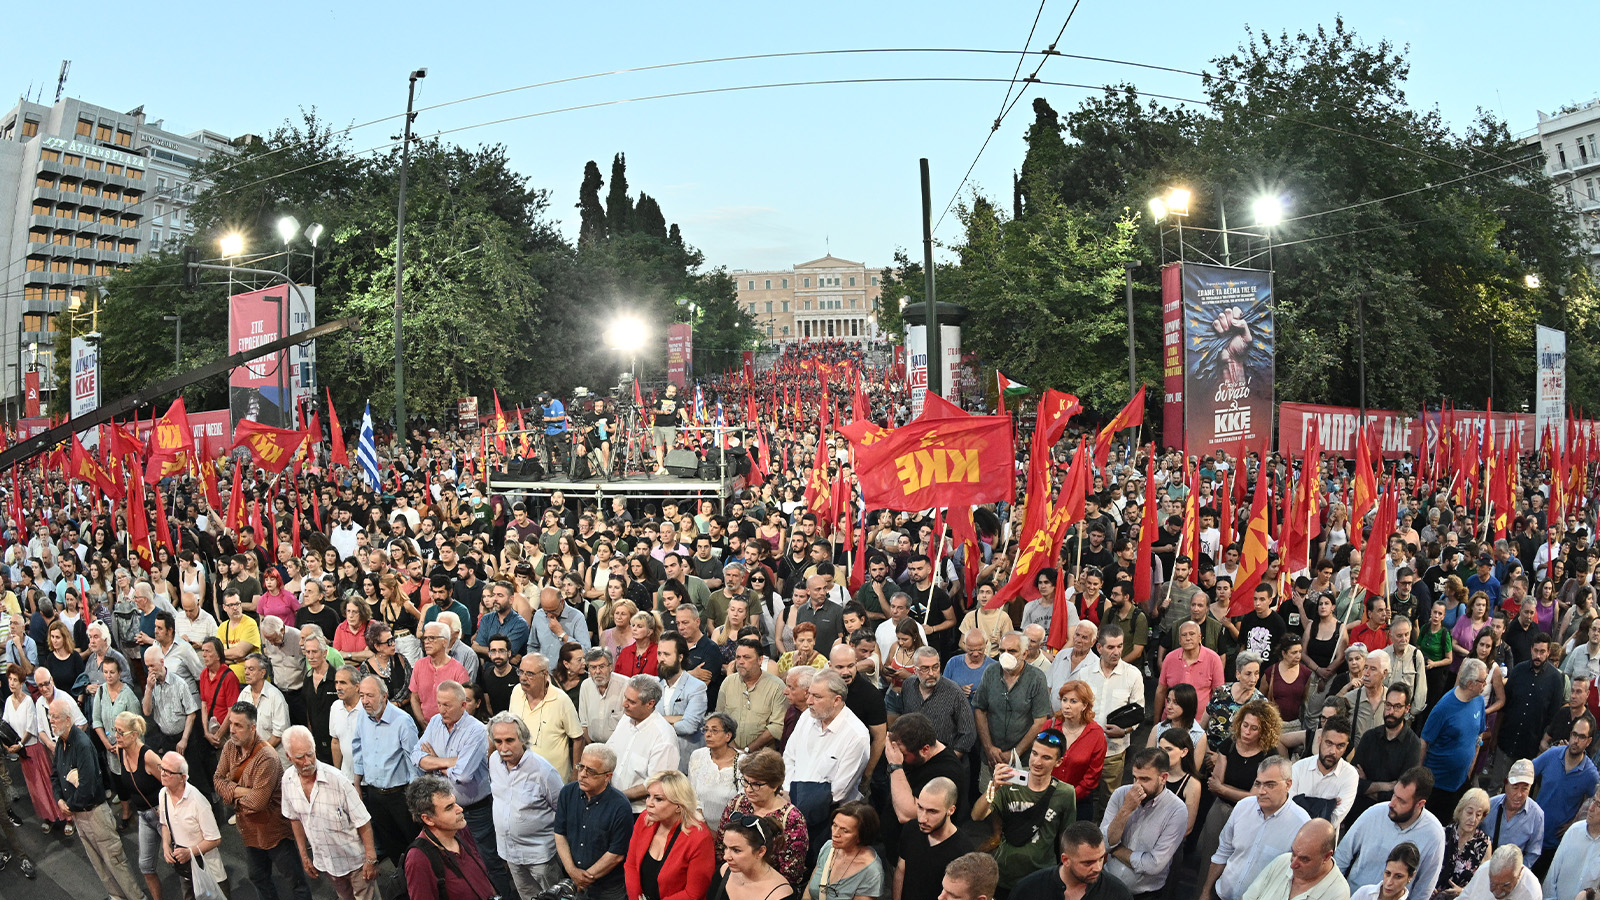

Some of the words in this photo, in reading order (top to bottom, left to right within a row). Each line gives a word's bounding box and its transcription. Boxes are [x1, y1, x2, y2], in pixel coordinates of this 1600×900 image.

[111, 150, 145, 168] PLAZA
[251, 320, 264, 334] ΣΤΙΣ
[75, 374, 95, 397] ΚΚΕ
[1214, 410, 1251, 433] ΚΚΕ
[1381, 416, 1413, 452] ΛΑΕ
